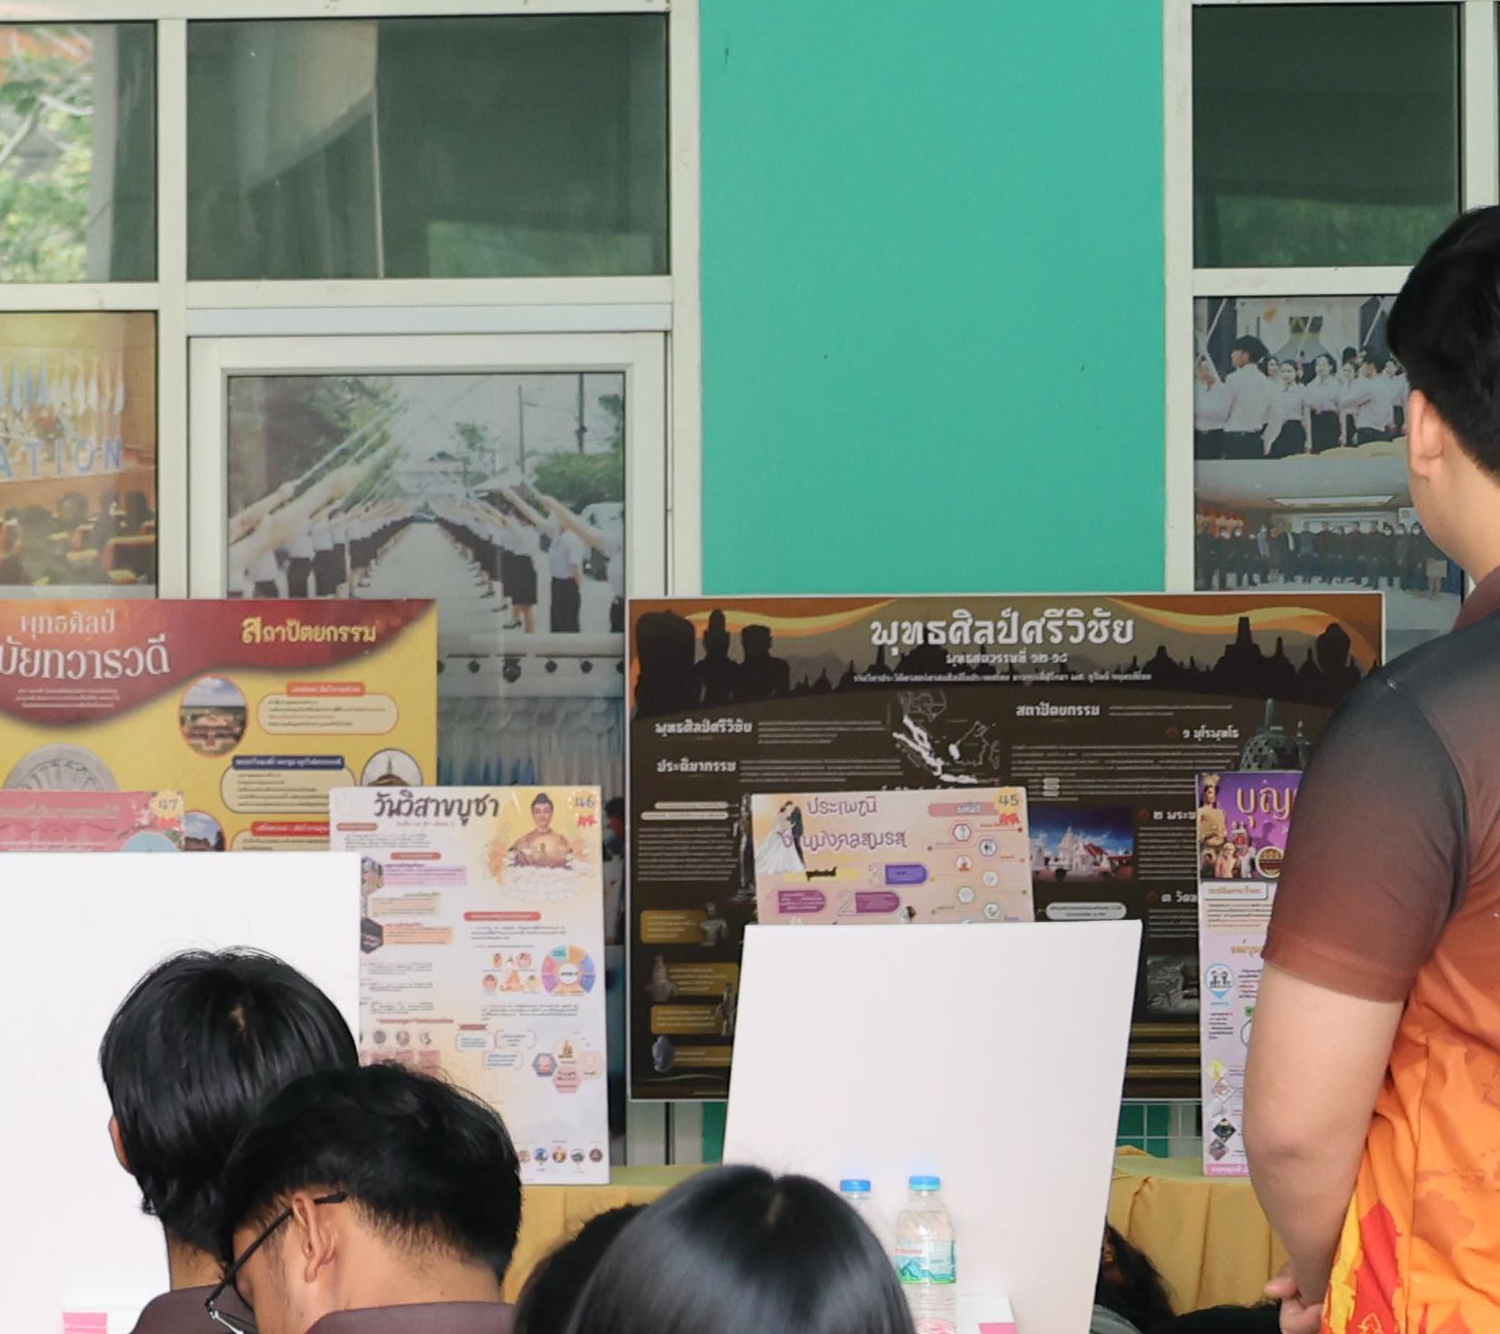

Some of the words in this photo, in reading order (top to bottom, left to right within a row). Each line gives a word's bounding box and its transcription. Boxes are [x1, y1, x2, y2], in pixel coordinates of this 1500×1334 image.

[19, 608, 115, 639] พุทธศิลป์
[242, 616, 378, 645] สถาปัตยกรรม
[869, 606, 1135, 657] พุทธศิลป์ศรีวิชัย
[373, 789, 500, 827] วันวิสาขบูชา
[998, 793, 1020, 808] 45
[777, 830, 909, 853] งนมงคลสมรส
